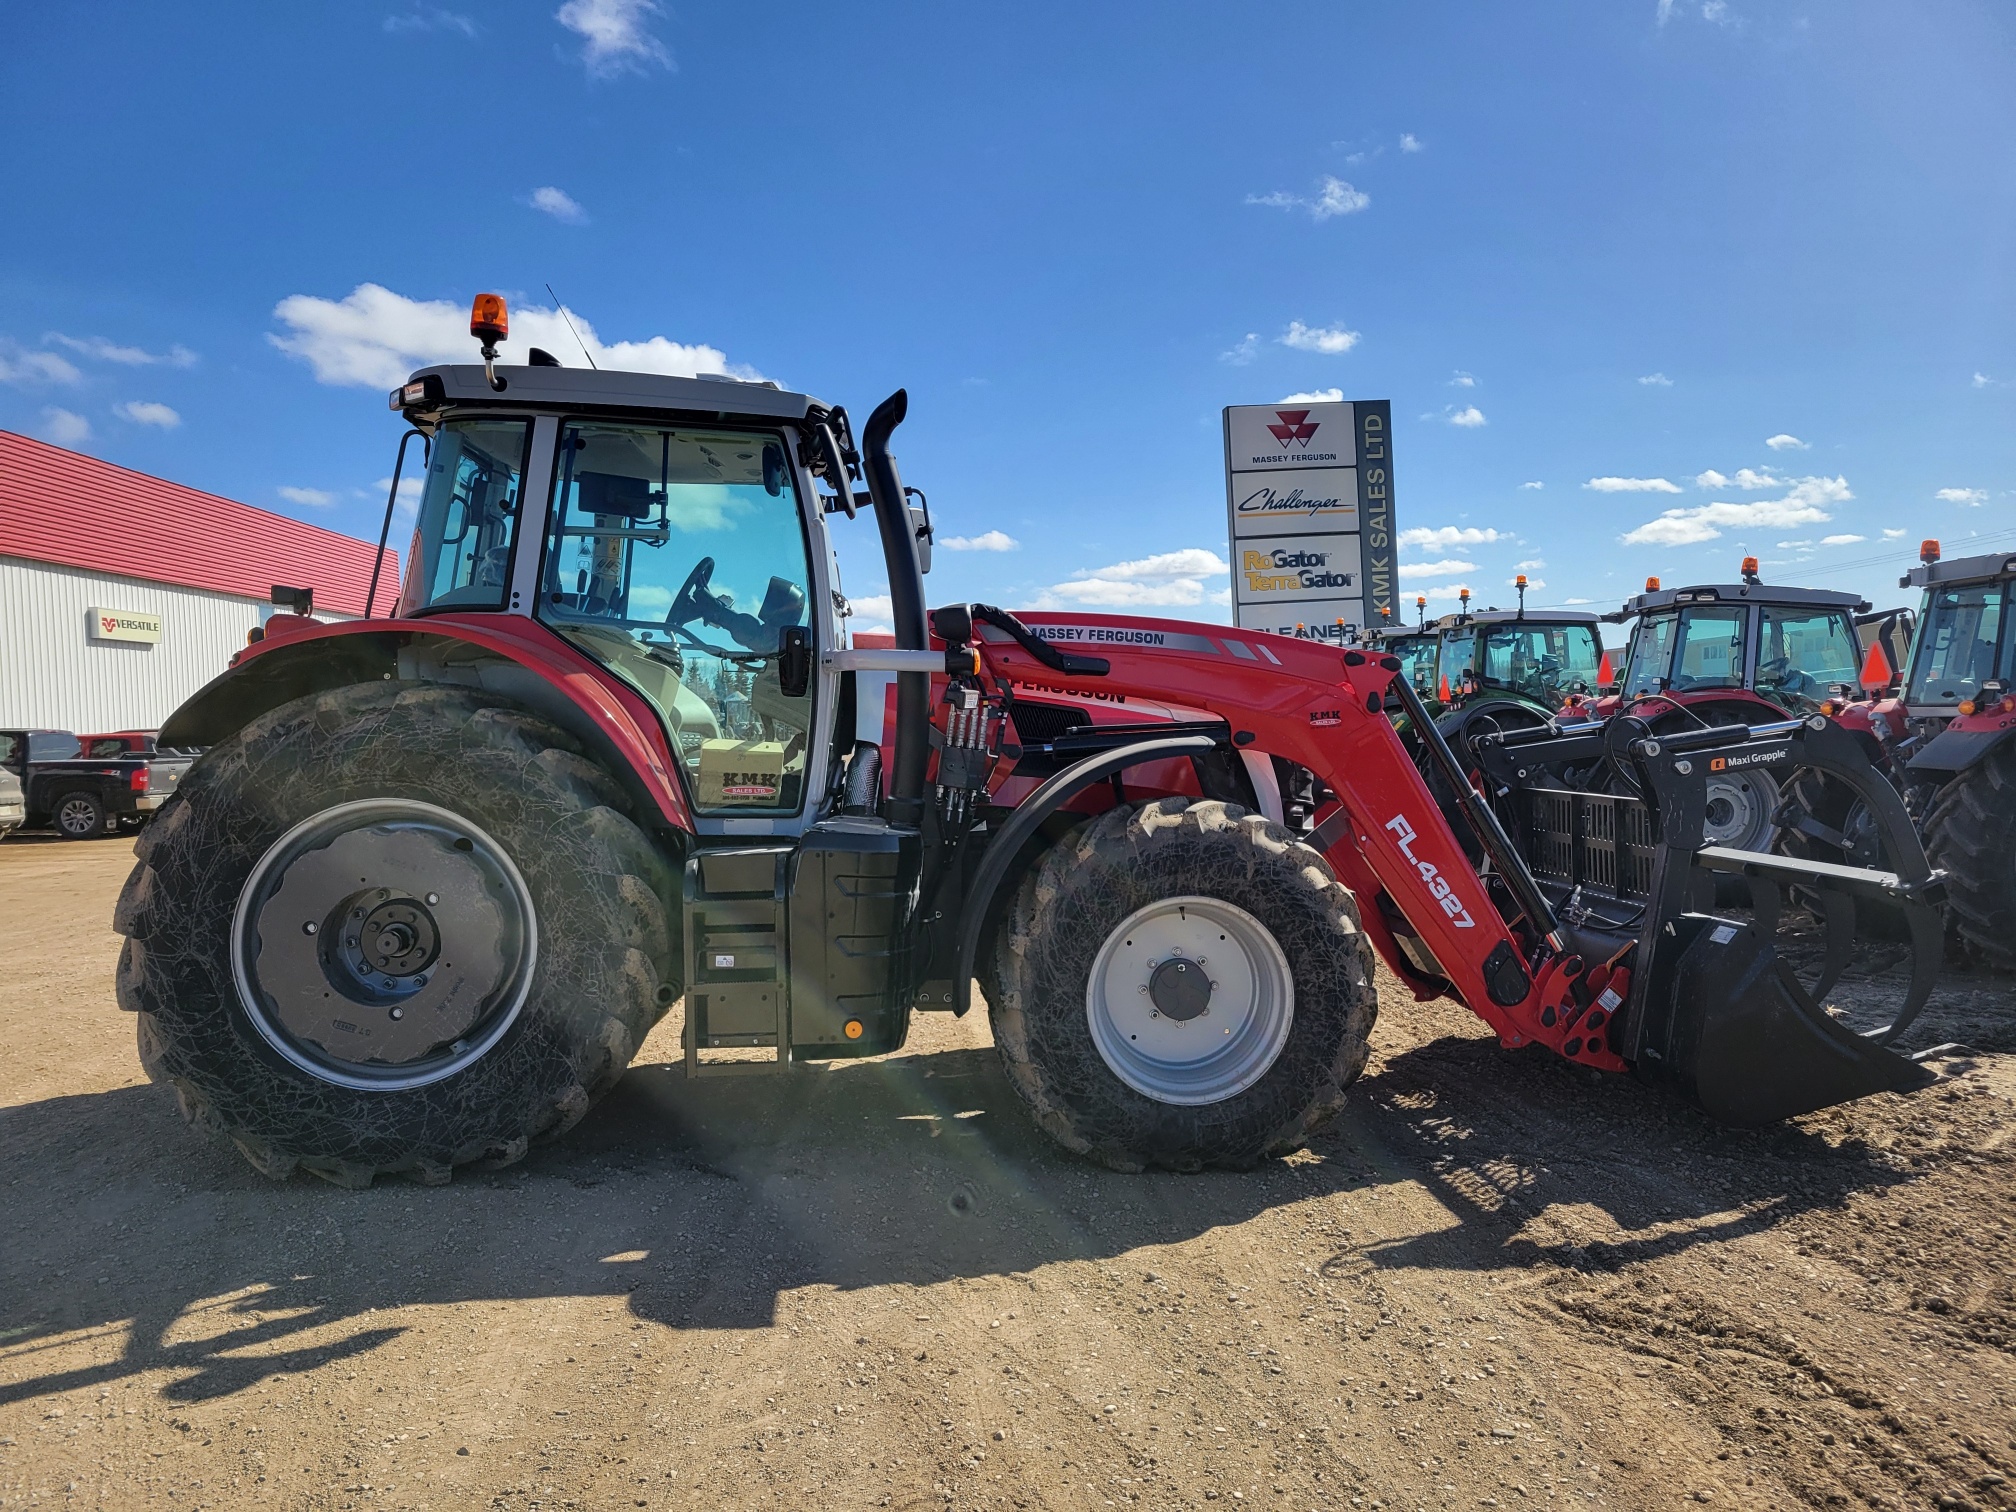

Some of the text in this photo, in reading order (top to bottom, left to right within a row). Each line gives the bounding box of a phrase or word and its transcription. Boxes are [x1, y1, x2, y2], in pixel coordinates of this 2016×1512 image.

[1252, 452, 1337, 464] MASSEY FERGUSON
[1238, 487, 1354, 516] Challenger
[1364, 414, 1391, 613] KMK SALES LTD
[1243, 549, 1329, 571] RoGator
[1244, 570, 1354, 592] TerraGator
[116, 618, 159, 632] VERSATILE
[1252, 623, 1357, 639] EANER
[1088, 629, 1165, 645] FERGUSON
[1728, 749, 1786, 767] Maxi Grapple
